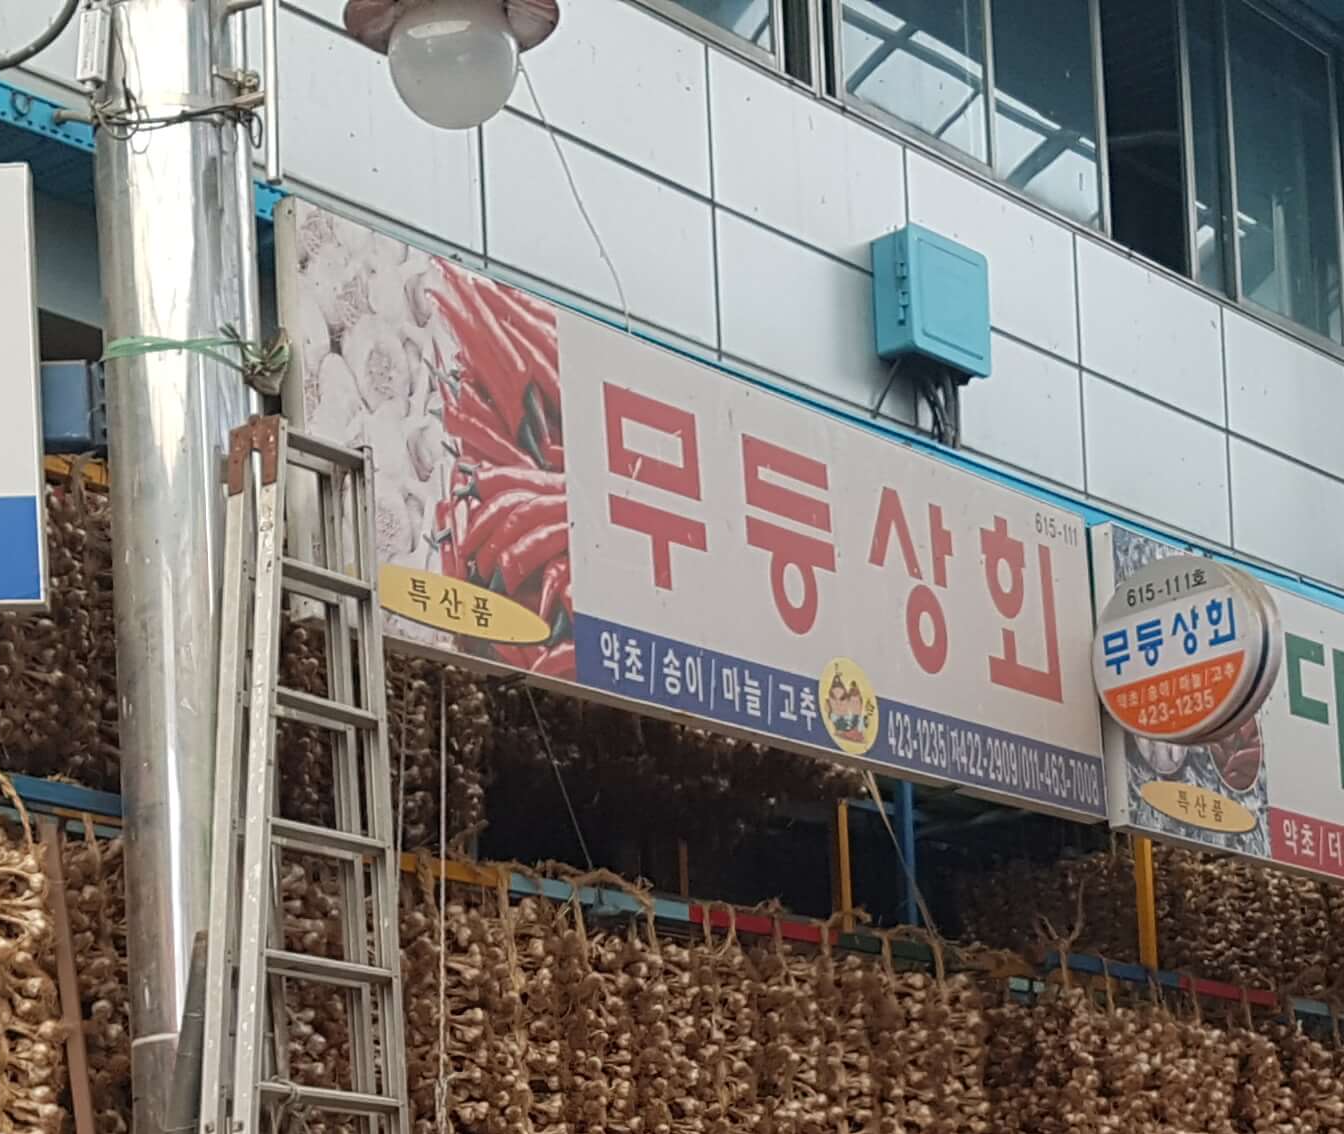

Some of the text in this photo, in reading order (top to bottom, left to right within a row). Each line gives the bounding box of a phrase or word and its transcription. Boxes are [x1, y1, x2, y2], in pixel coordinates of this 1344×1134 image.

[602, 380, 1064, 704] 무등상회
[1034, 510, 1079, 549] 615-111
[407, 576, 493, 628] 특산품
[1127, 568, 1207, 607] 615-111호
[1102, 597, 1237, 676] 무등상회
[1138, 688, 1216, 727] 423-1235
[1177, 789, 1224, 823] 특산품
